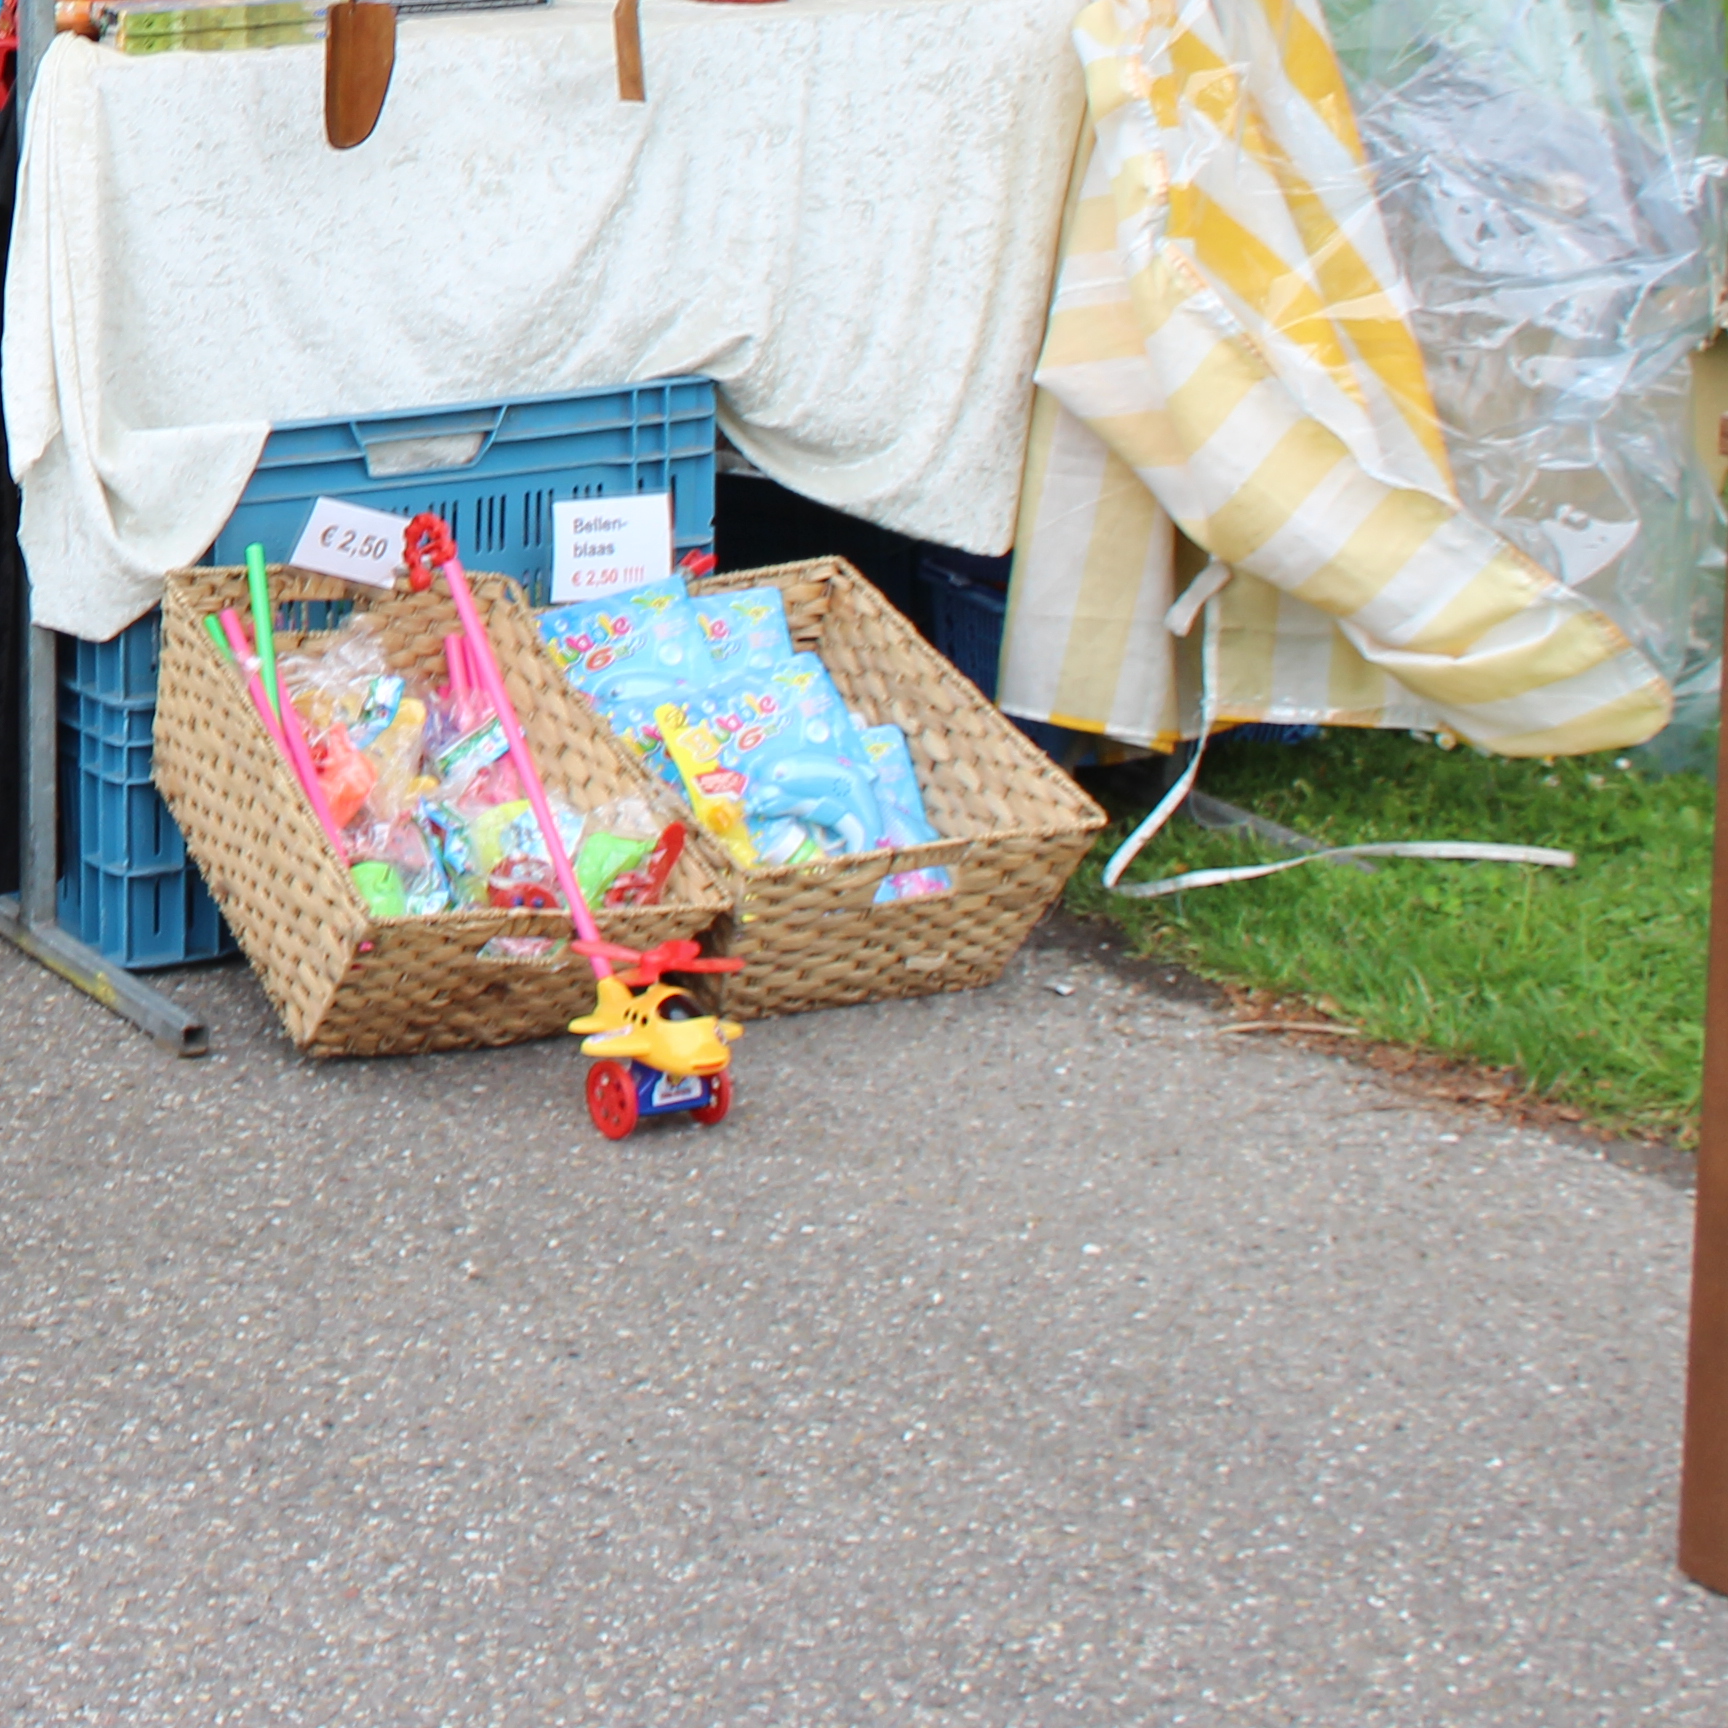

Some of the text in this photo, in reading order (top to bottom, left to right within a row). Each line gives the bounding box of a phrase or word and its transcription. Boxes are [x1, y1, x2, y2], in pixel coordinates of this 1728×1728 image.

[573, 516, 628, 534] Bellen-
[320, 524, 388, 560] € 2,50
[573, 542, 615, 558] blaas
[572, 570, 581, 587] €
[586, 568, 618, 587] 2,50
